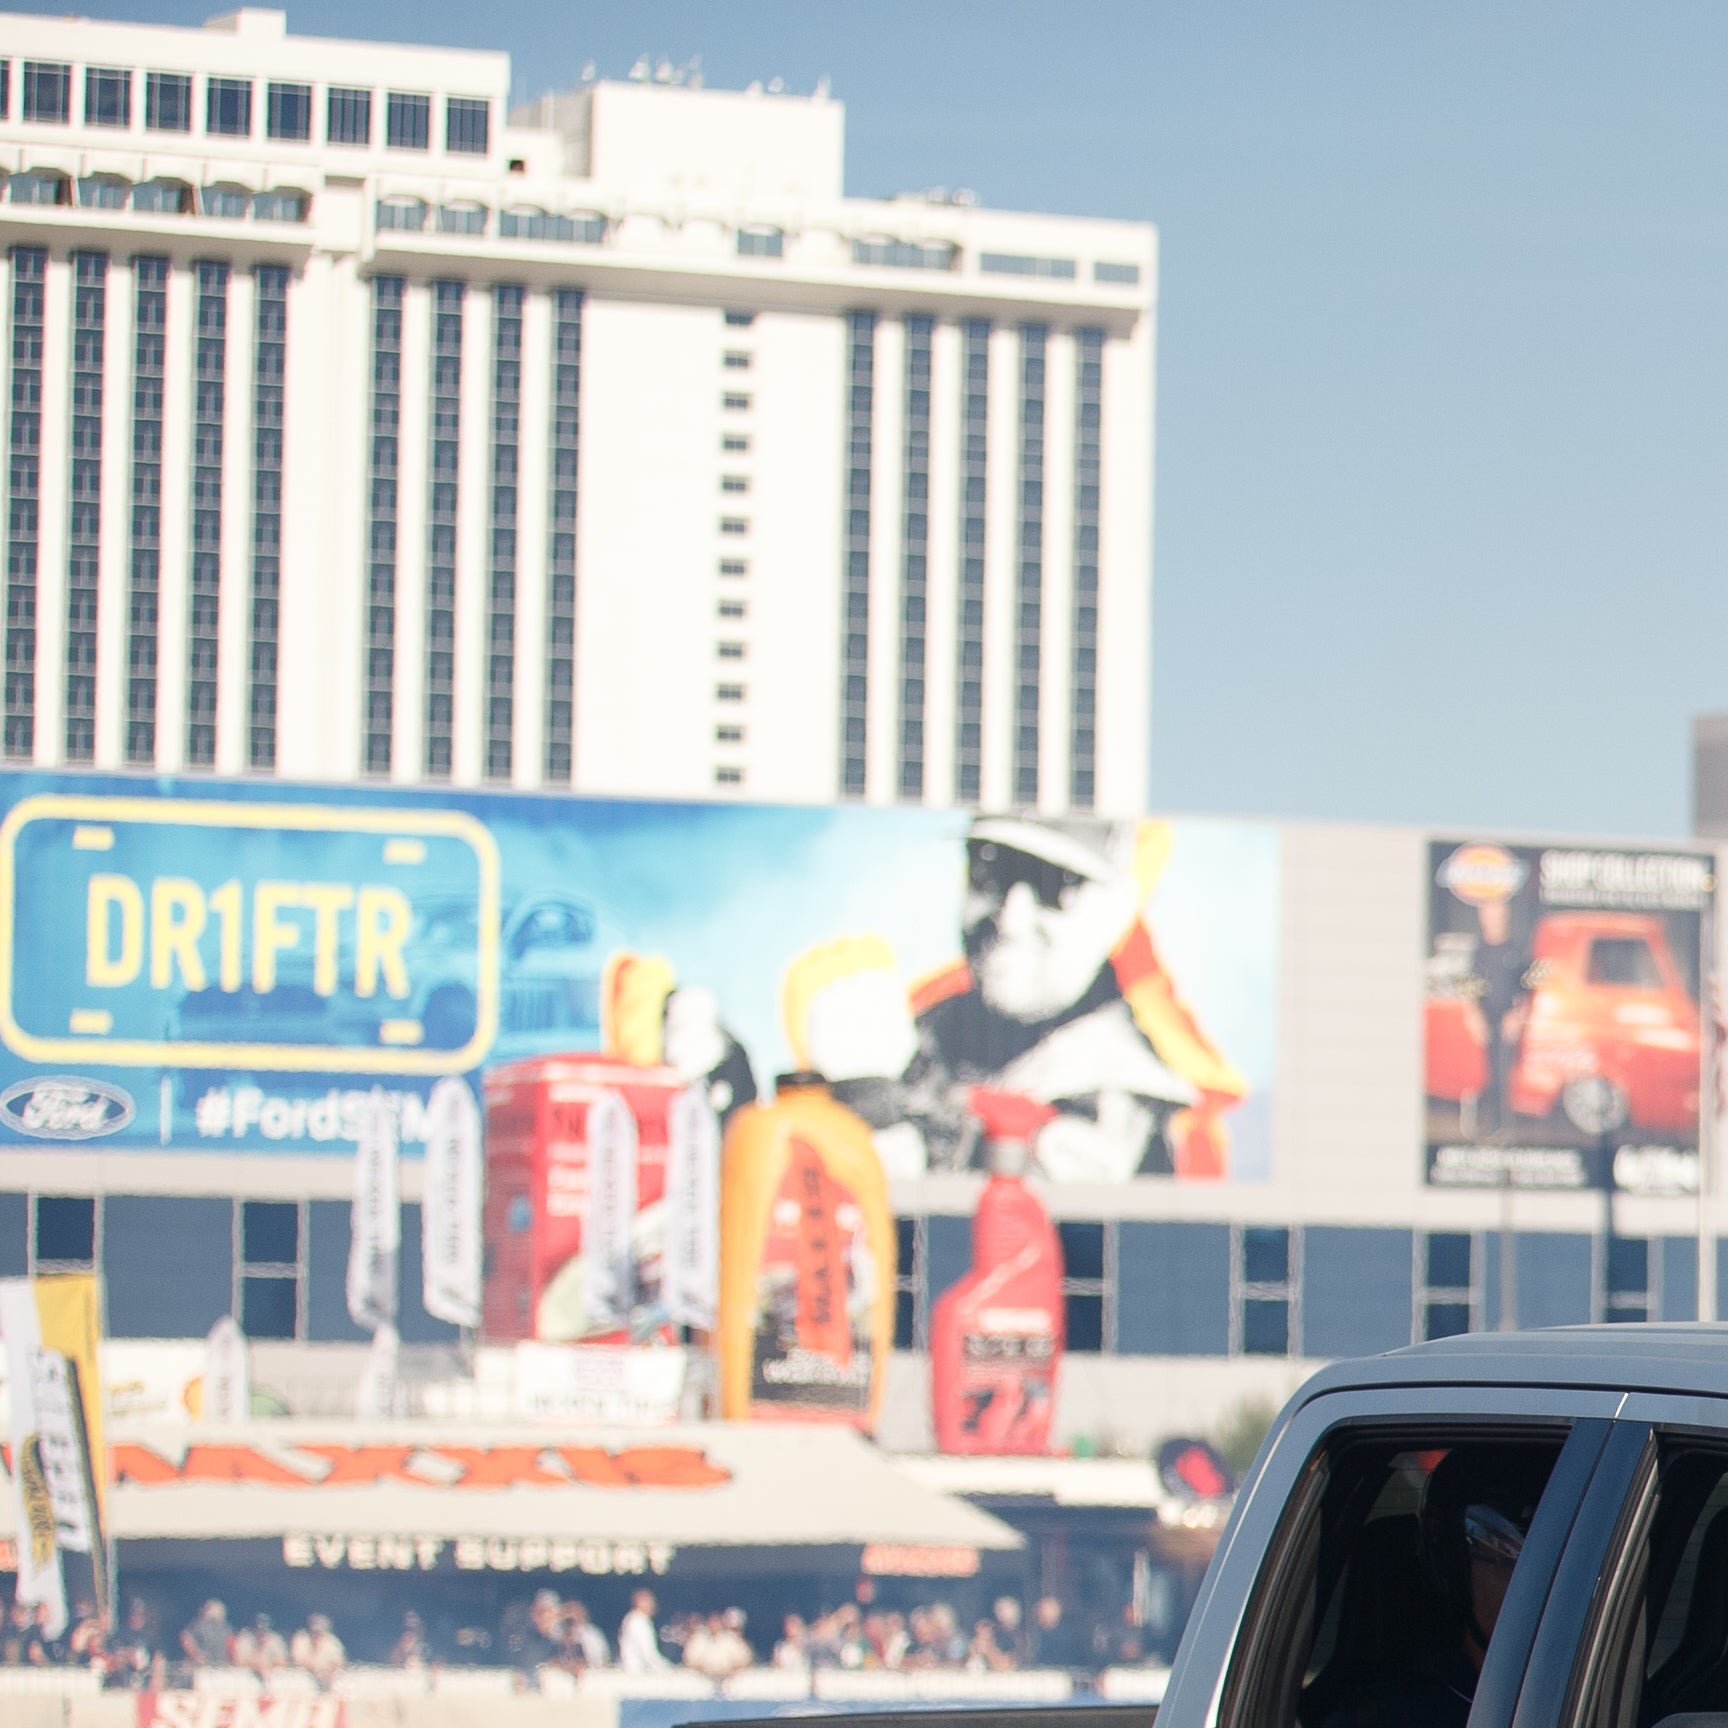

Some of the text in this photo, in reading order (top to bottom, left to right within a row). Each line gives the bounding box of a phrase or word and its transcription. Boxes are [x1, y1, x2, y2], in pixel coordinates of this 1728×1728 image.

[84, 872, 412, 999] DR1FTR
[282, 1532, 678, 1576] EVENT SUPPORT
